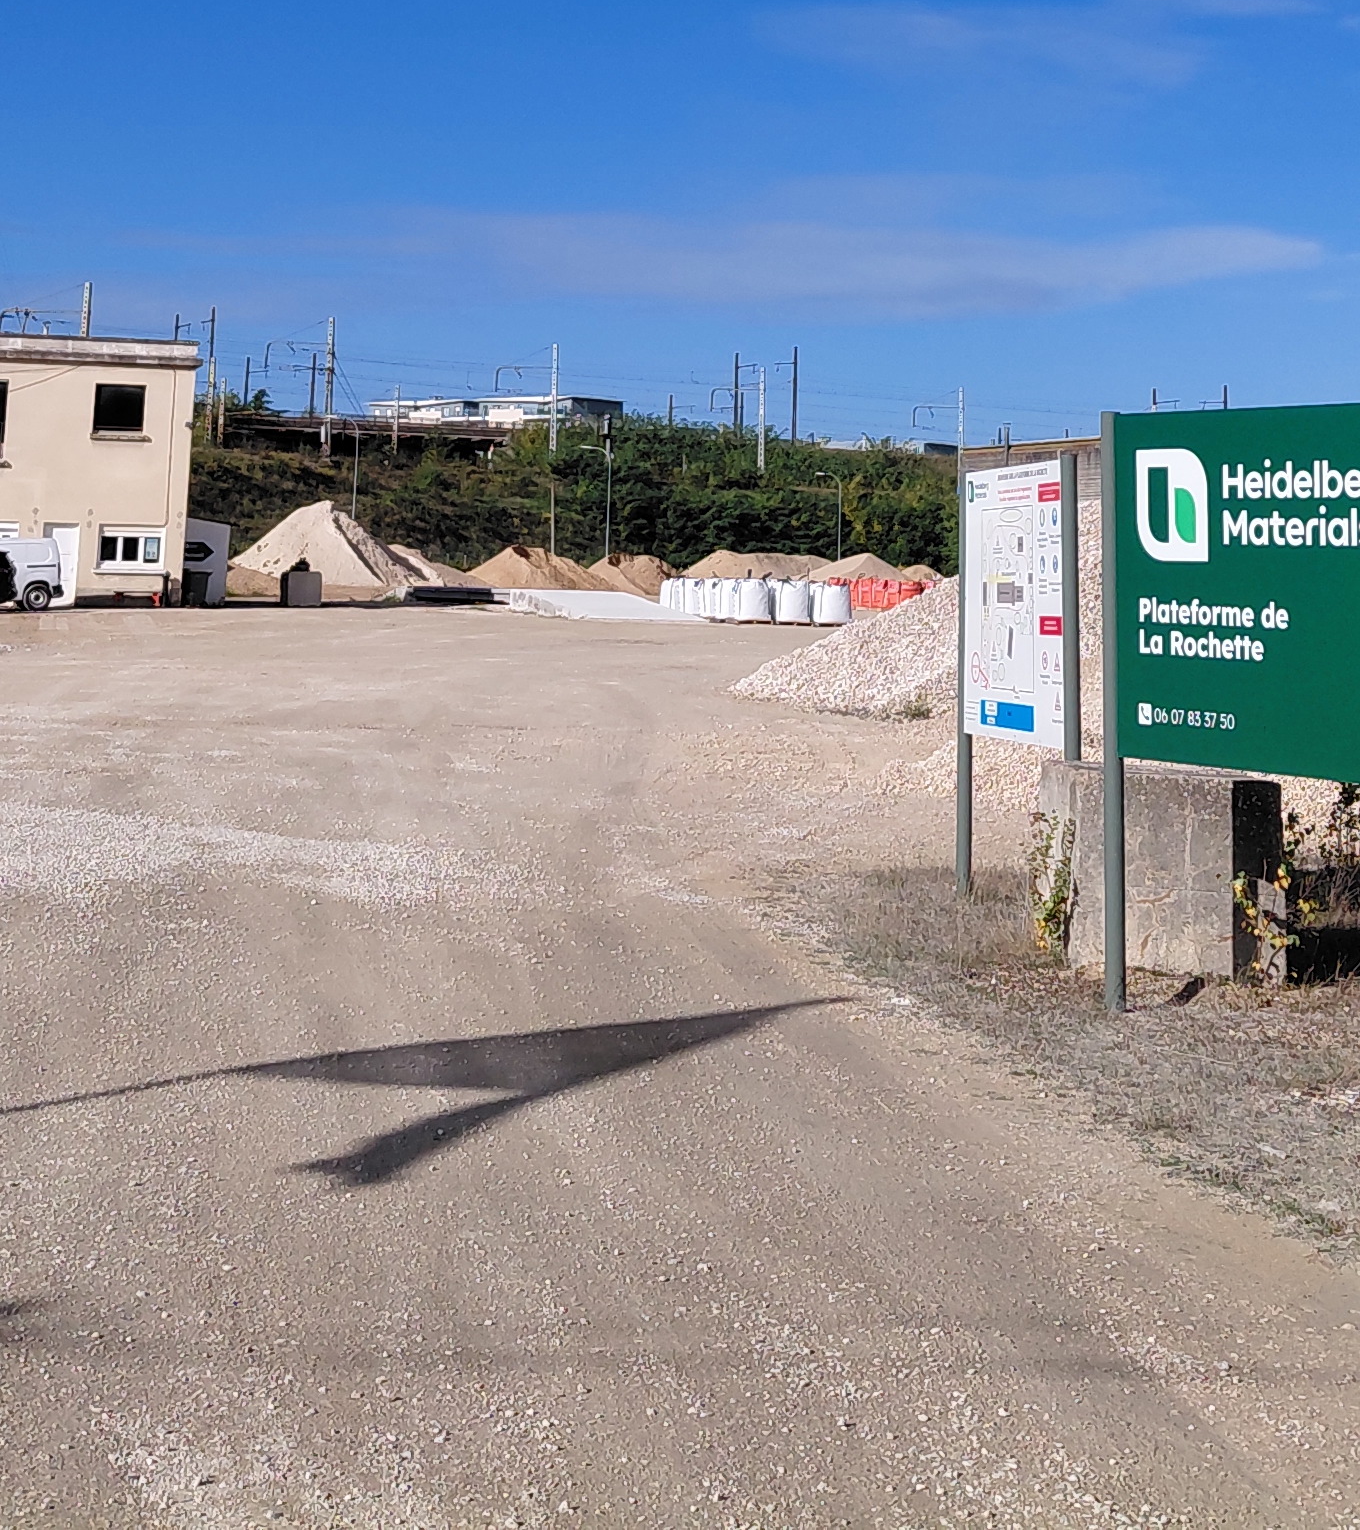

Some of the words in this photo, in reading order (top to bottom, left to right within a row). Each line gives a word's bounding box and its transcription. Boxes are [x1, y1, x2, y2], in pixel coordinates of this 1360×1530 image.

[1139, 597, 1254, 628] Plateforme
[1261, 601, 1289, 629] de
[1140, 629, 1163, 654] La
[1171, 631, 1264, 661] Rochette
[1154, 707, 1169, 724] 06
[1171, 708, 1185, 725] 07
[1187, 710, 1202, 727] 83
[1203, 711, 1217, 729] 37
[1219, 713, 1235, 730] 50
